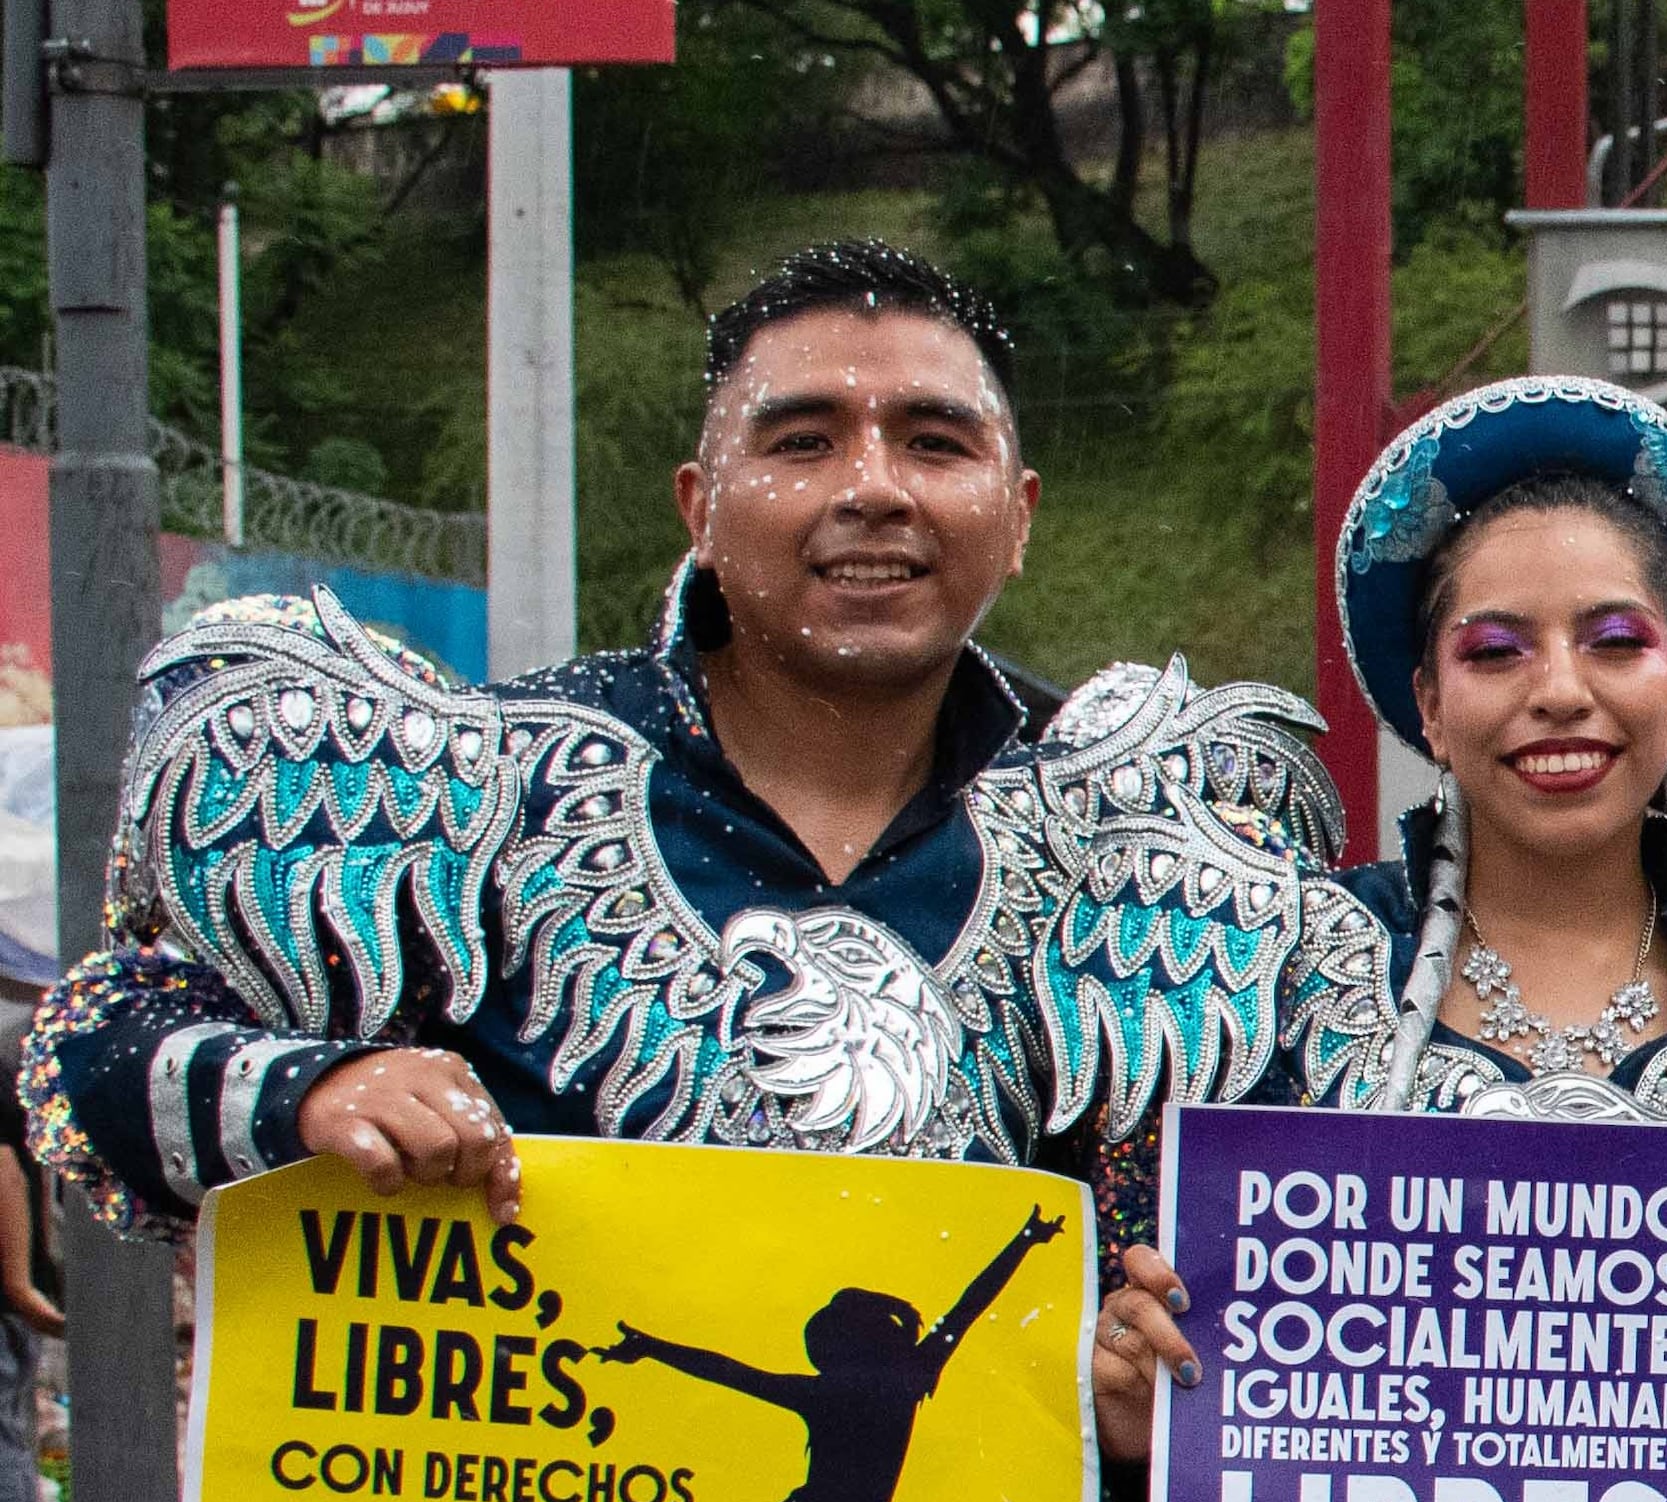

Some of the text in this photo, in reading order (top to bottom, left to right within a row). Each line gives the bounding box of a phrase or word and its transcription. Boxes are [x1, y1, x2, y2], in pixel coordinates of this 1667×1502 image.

[1239, 1171, 1367, 1229] POR
[1391, 1177, 1463, 1233] UN
[297, 1207, 560, 1329] VIVAS,
[1236, 1237, 1433, 1297] DONDE
[293, 1319, 614, 1447] LIBRES,
[1222, 1369, 1445, 1428] IGUALES,
[272, 1441, 402, 1495] CON
[1222, 1425, 1666, 1470] DIFERENTES Y TOTALMENTE
